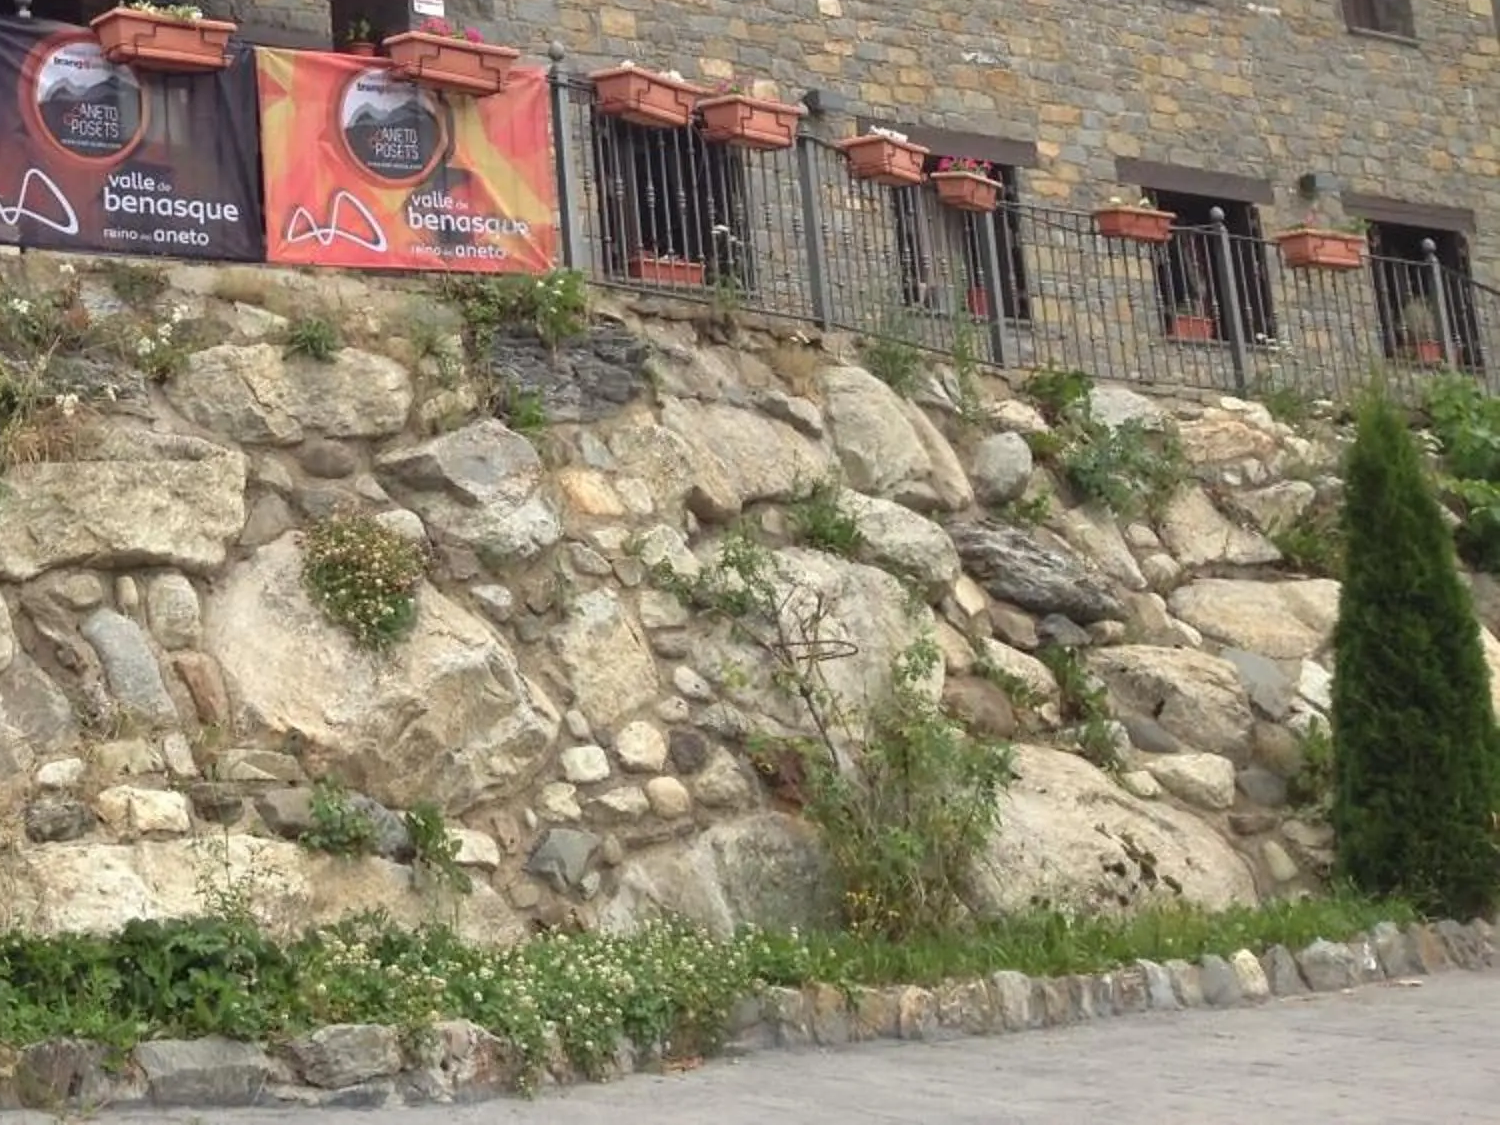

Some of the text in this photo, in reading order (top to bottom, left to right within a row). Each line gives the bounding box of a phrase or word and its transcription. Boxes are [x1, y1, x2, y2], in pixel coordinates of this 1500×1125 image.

[79, 102, 119, 122] ANETO
[70, 118, 120, 139] POSETS
[375, 141, 419, 160] POSETS
[108, 171, 172, 192] valle de
[103, 186, 239, 225] benasque
[411, 190, 454, 210] valle
[407, 205, 530, 239] benasque
[103, 227, 139, 241] reino
[153, 228, 210, 247] aneto
[454, 243, 507, 260] aneto
